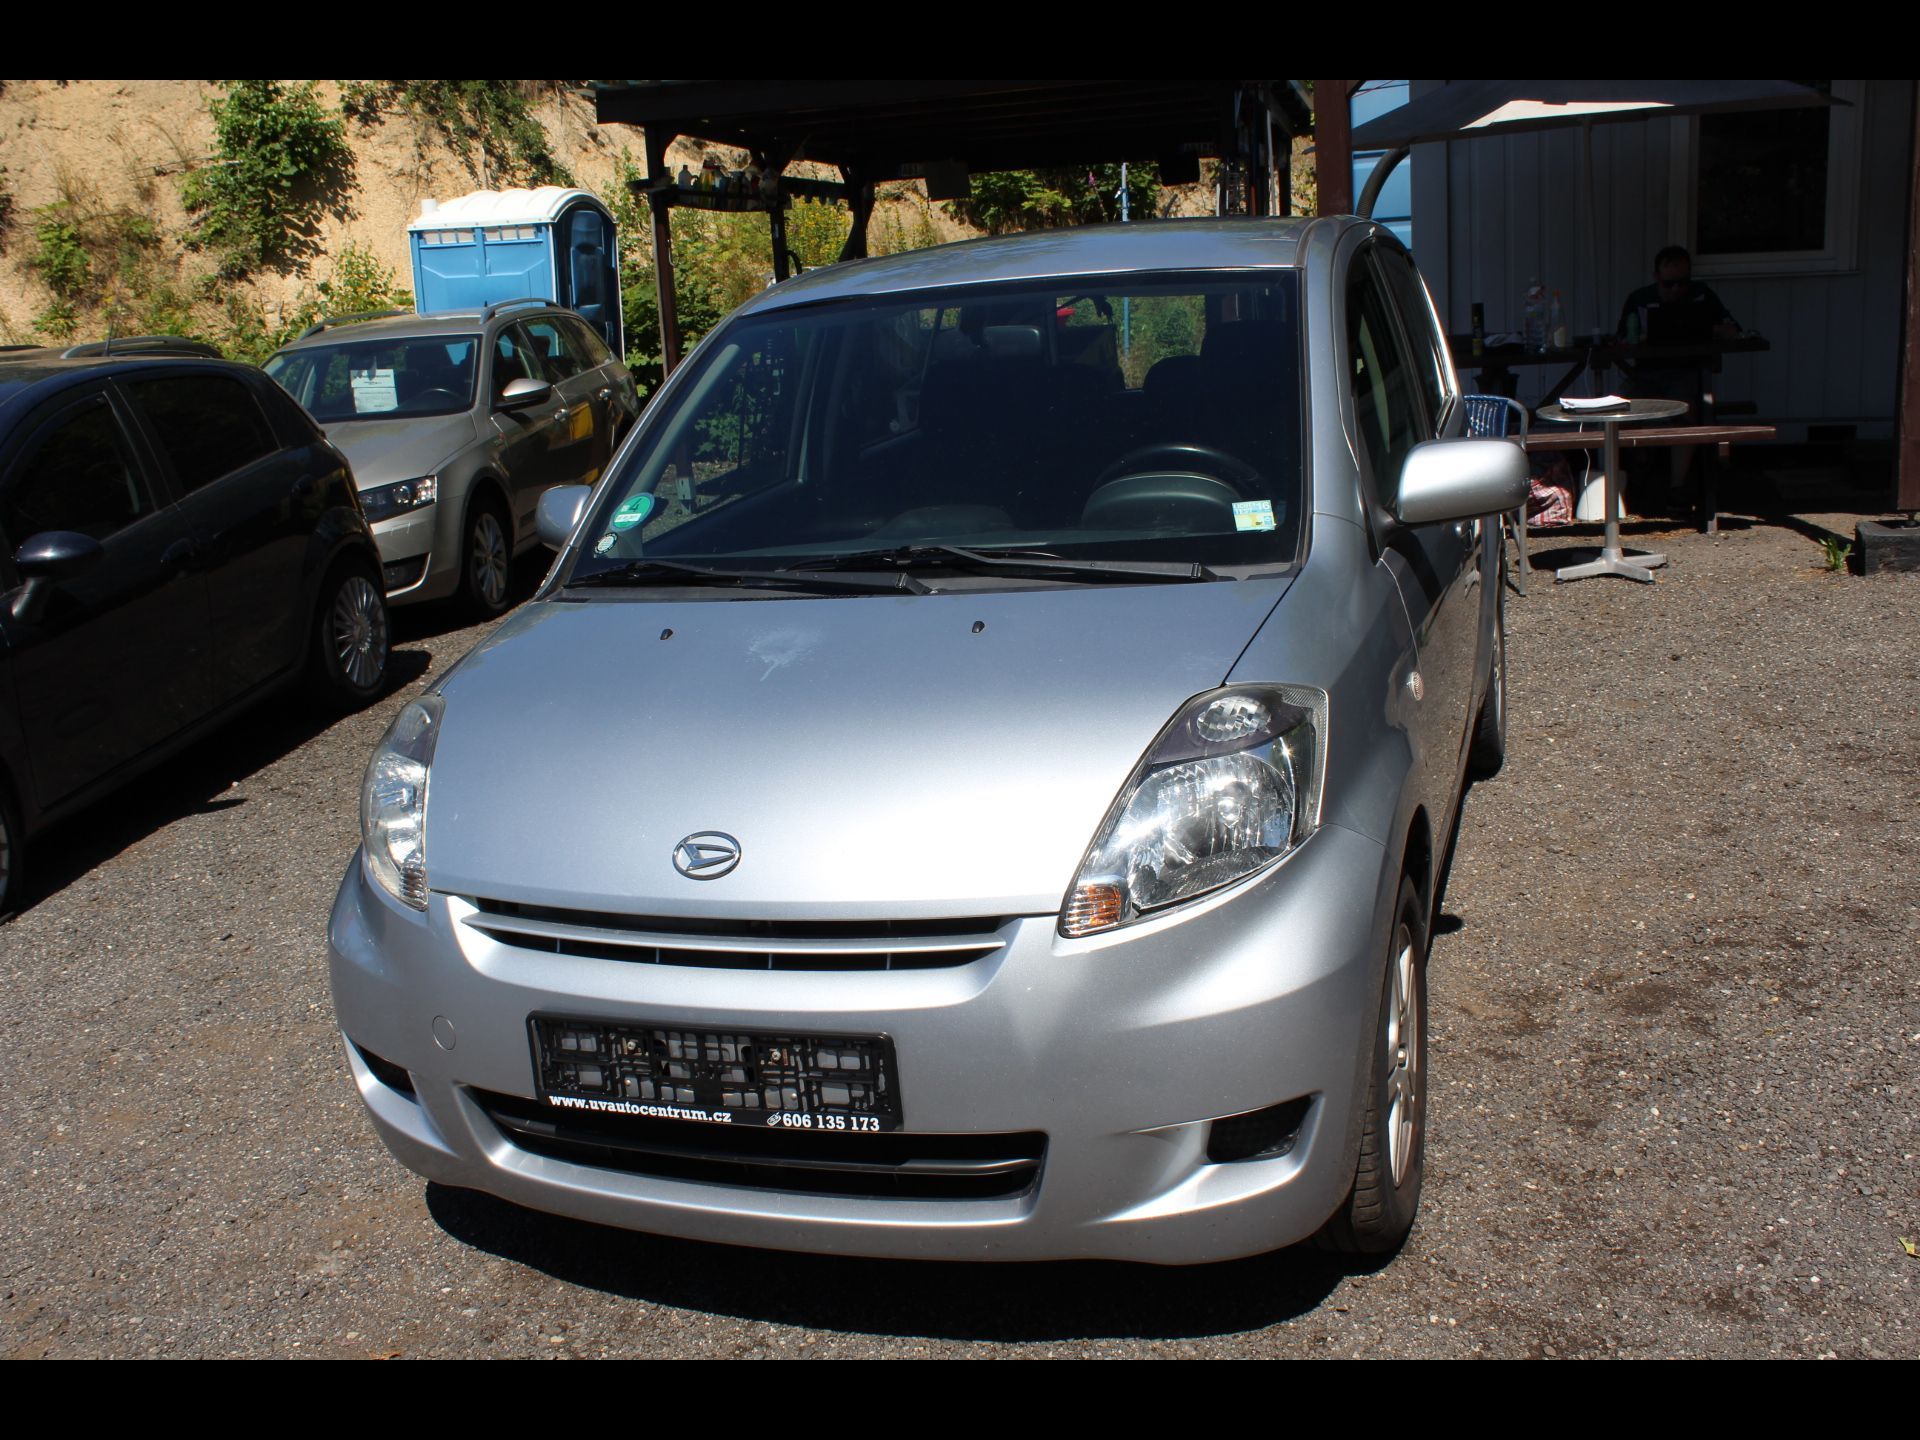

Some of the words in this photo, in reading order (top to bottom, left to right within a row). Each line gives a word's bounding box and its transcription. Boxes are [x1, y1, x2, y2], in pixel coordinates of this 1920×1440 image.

[549, 1095, 731, 1123] www.uvautocentrum.cz
[783, 1113, 812, 1128] 606
[817, 1115, 846, 1130] 135
[850, 1116, 880, 1132] 173
